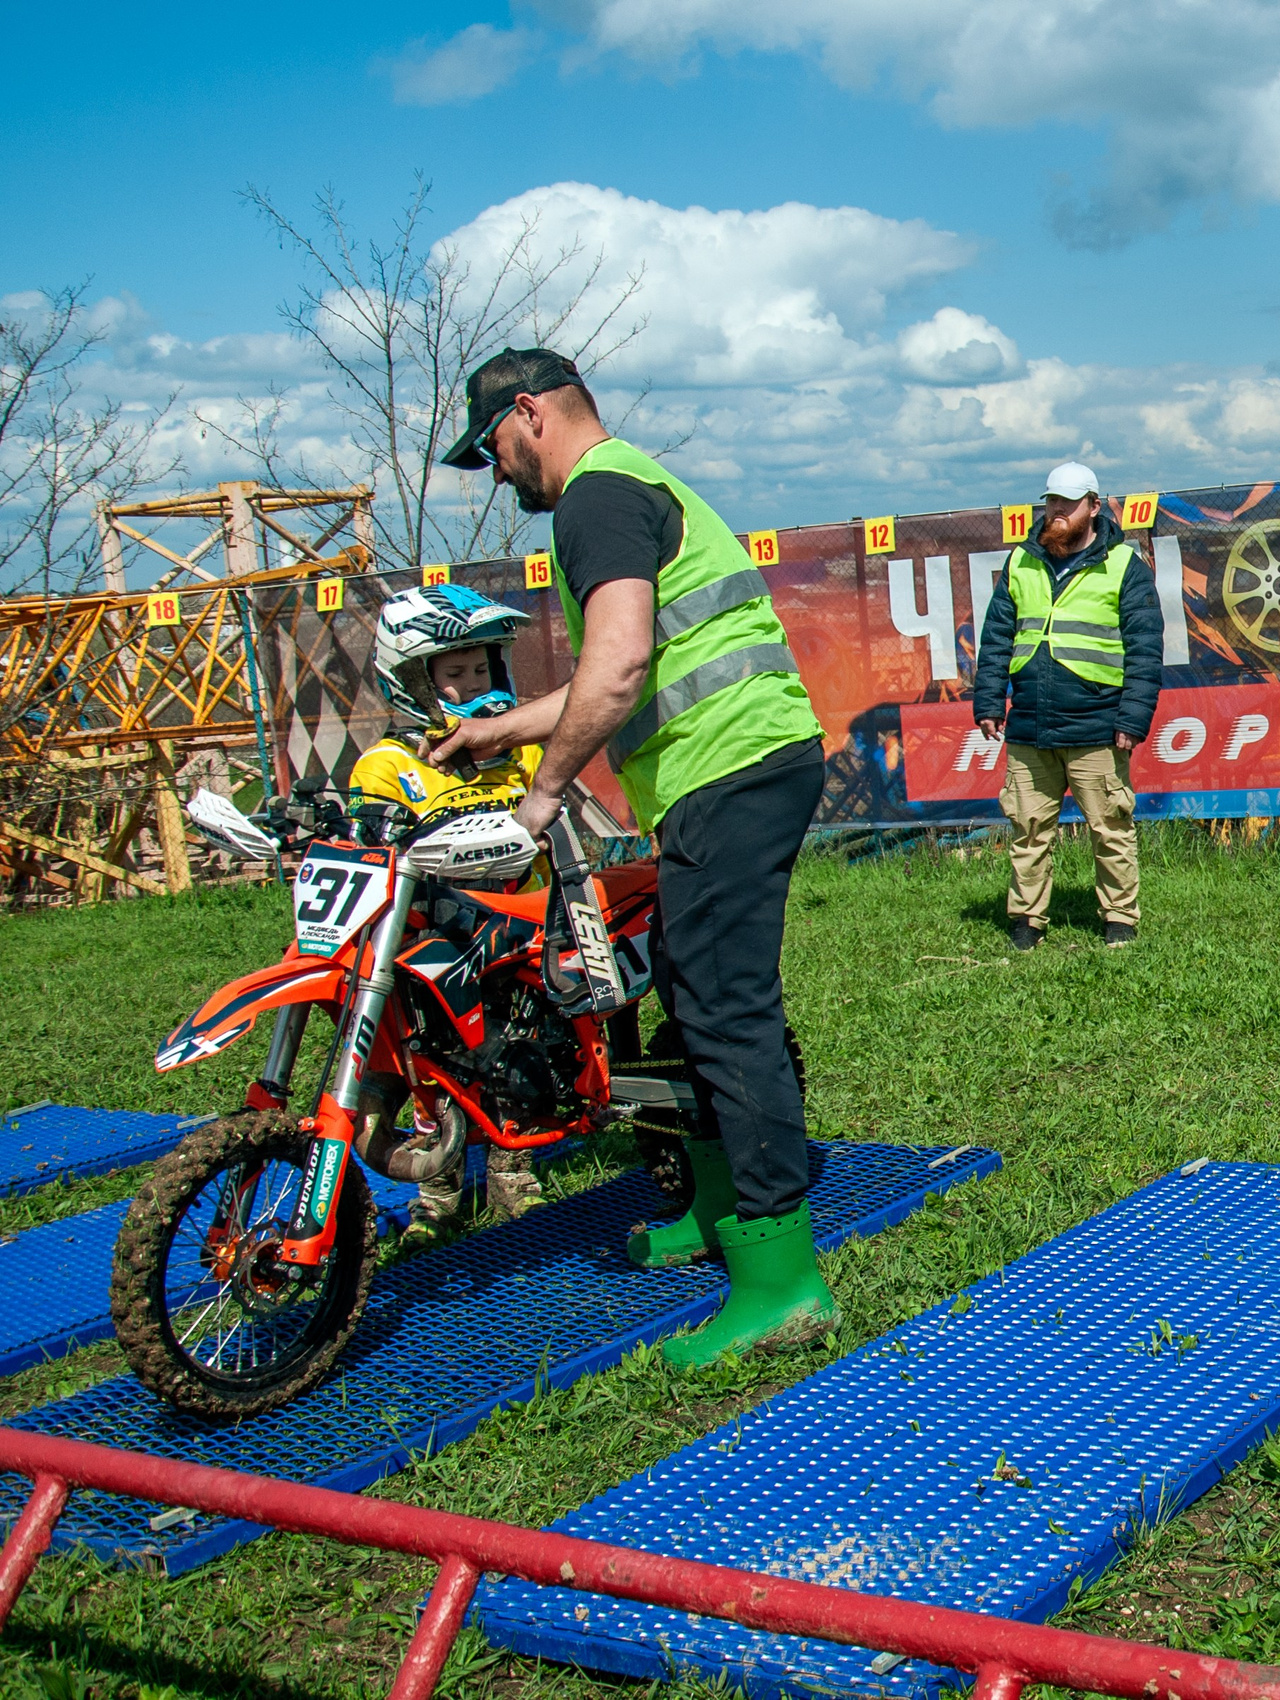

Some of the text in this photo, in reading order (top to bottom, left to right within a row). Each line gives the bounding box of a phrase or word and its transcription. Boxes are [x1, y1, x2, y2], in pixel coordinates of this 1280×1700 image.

[1130, 501, 1152, 524] 10
[870, 524, 889, 548] 12
[1008, 513, 1025, 537] 11
[755, 538, 775, 561] 13
[428, 571, 446, 586] 16
[529, 561, 548, 583] 15
[323, 585, 338, 606] 17
[154, 599, 176, 620] 18
[447, 788, 494, 804] TEAM
[360, 852, 386, 865] KTM
[453, 841, 524, 864] ACERBIS
[297, 867, 374, 927] 31
[297, 1141, 321, 1218] DUNLOP
[318, 1143, 340, 1201] MOTOREX
